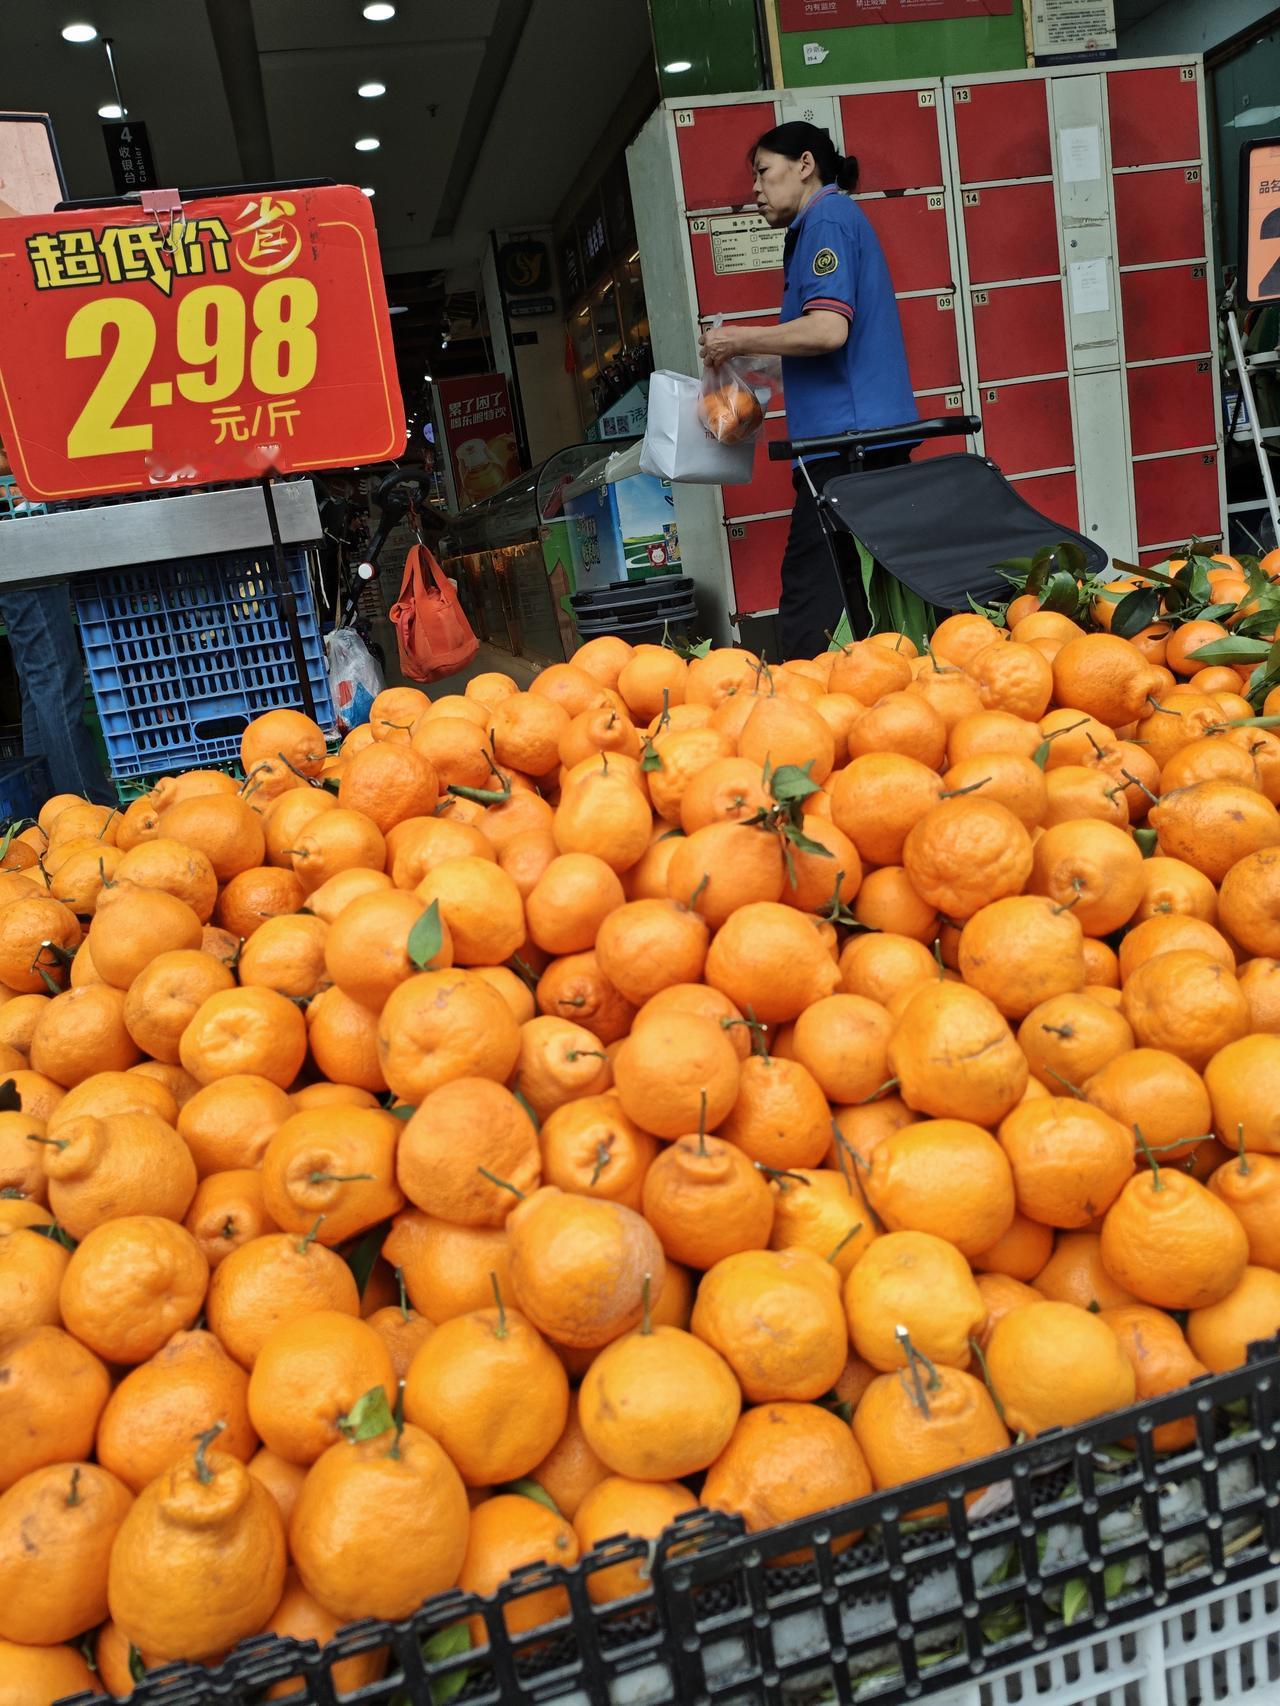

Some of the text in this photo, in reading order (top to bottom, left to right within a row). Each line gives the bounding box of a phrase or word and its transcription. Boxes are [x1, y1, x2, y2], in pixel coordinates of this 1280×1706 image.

[805, 2, 837, 11] 内有监控
[1182, 69, 1193, 79] 19
[920, 94, 932, 103] 07
[957, 91, 969, 100] 13
[680, 114, 691, 123] 01
[121, 127, 132, 142] 4
[119, 146, 135, 183] 收银台
[1186, 171, 1197, 180] 20
[930, 197, 941, 206] 08
[966, 193, 977, 203] 14
[693, 221, 705, 230] 02
[234, 197, 302, 275] 省
[25, 217, 232, 297] 超低价
[1193, 268, 1204, 277] 21
[975, 293, 986, 302] 15
[939, 298, 951, 307] 09
[65, 277, 318, 459] 2.98
[1198, 362, 1209, 372] 22
[448, 391, 502, 416] 累了困了
[949, 397, 959, 405] 10
[211, 399, 301, 444] 元/斤
[731, 528, 744, 537] 05
